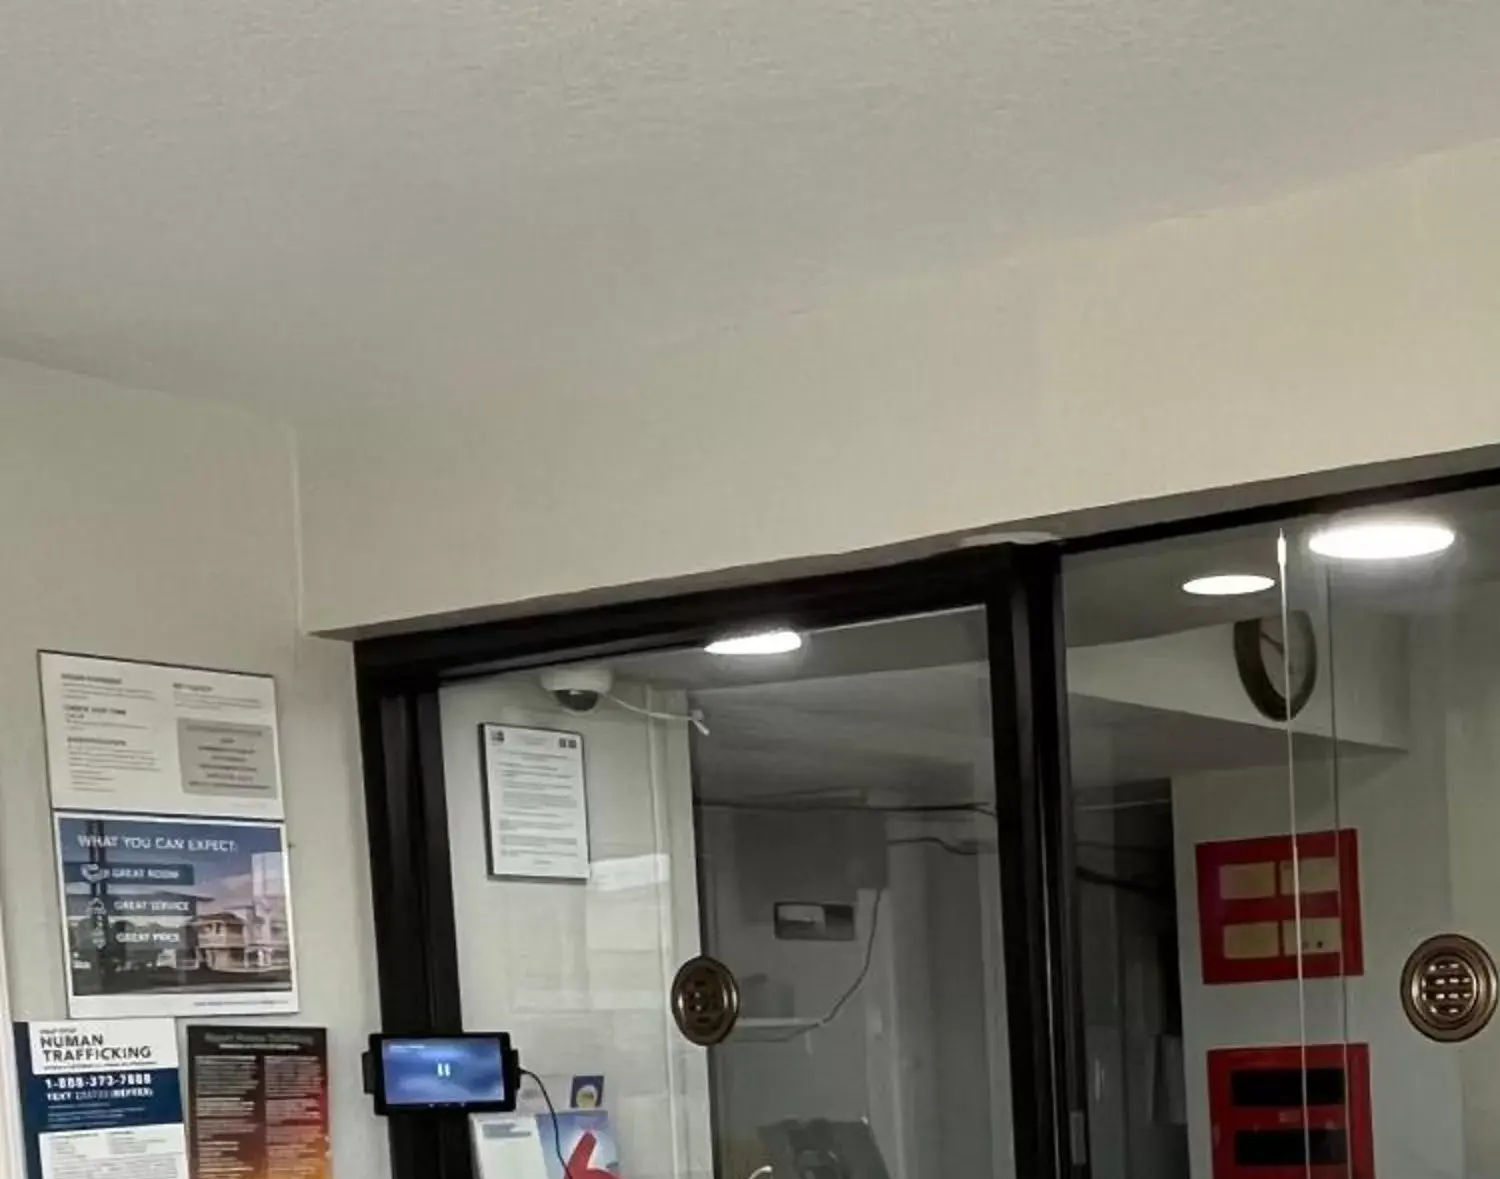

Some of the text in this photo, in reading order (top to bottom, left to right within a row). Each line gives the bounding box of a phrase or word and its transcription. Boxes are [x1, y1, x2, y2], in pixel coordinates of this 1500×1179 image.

[77, 835, 118, 847] WHAT
[123, 836, 150, 849] YOU
[155, 837, 184, 850] CAN
[40, 1033, 104, 1048] HUMAN
[43, 1045, 152, 1062] TRAFFICKING
